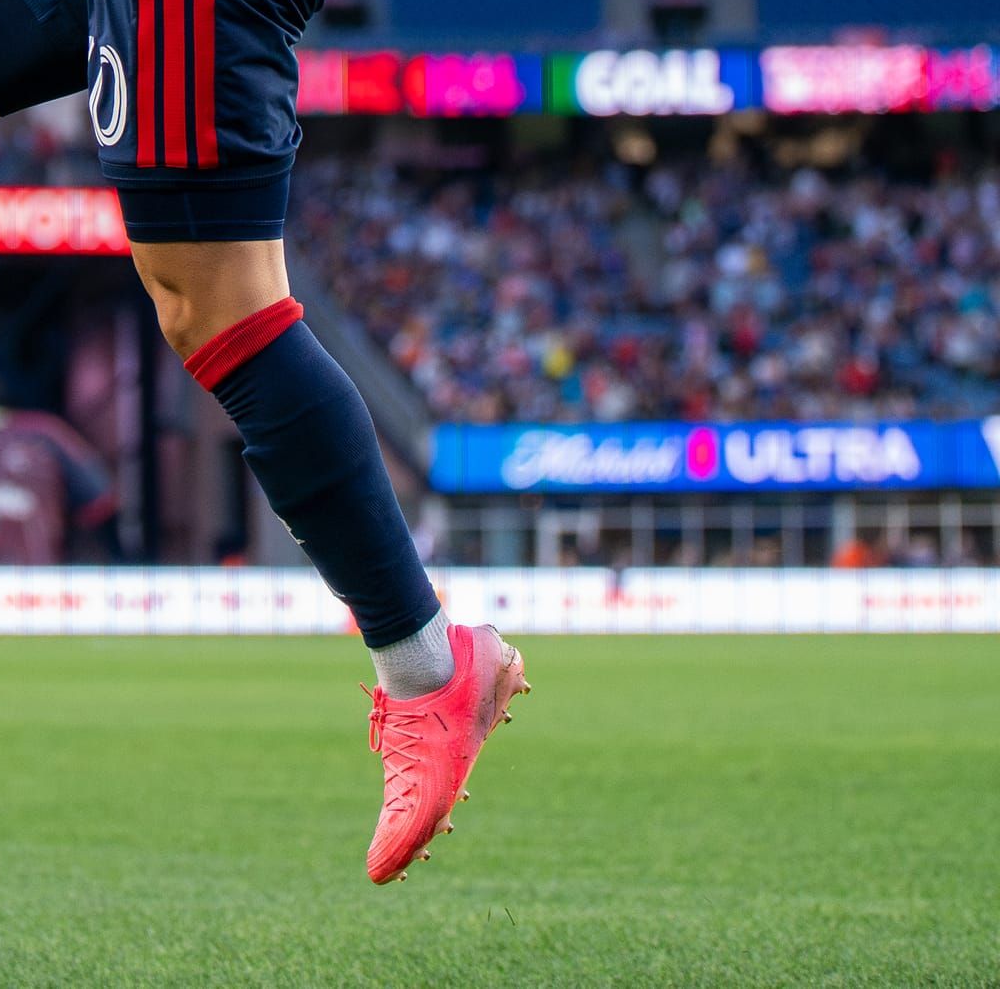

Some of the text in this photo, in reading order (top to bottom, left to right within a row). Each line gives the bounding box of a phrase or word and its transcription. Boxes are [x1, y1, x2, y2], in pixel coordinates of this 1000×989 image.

[87, 35, 128, 147] 0
[576, 49, 734, 116] GOAL
[724, 428, 920, 483] ULTRA
